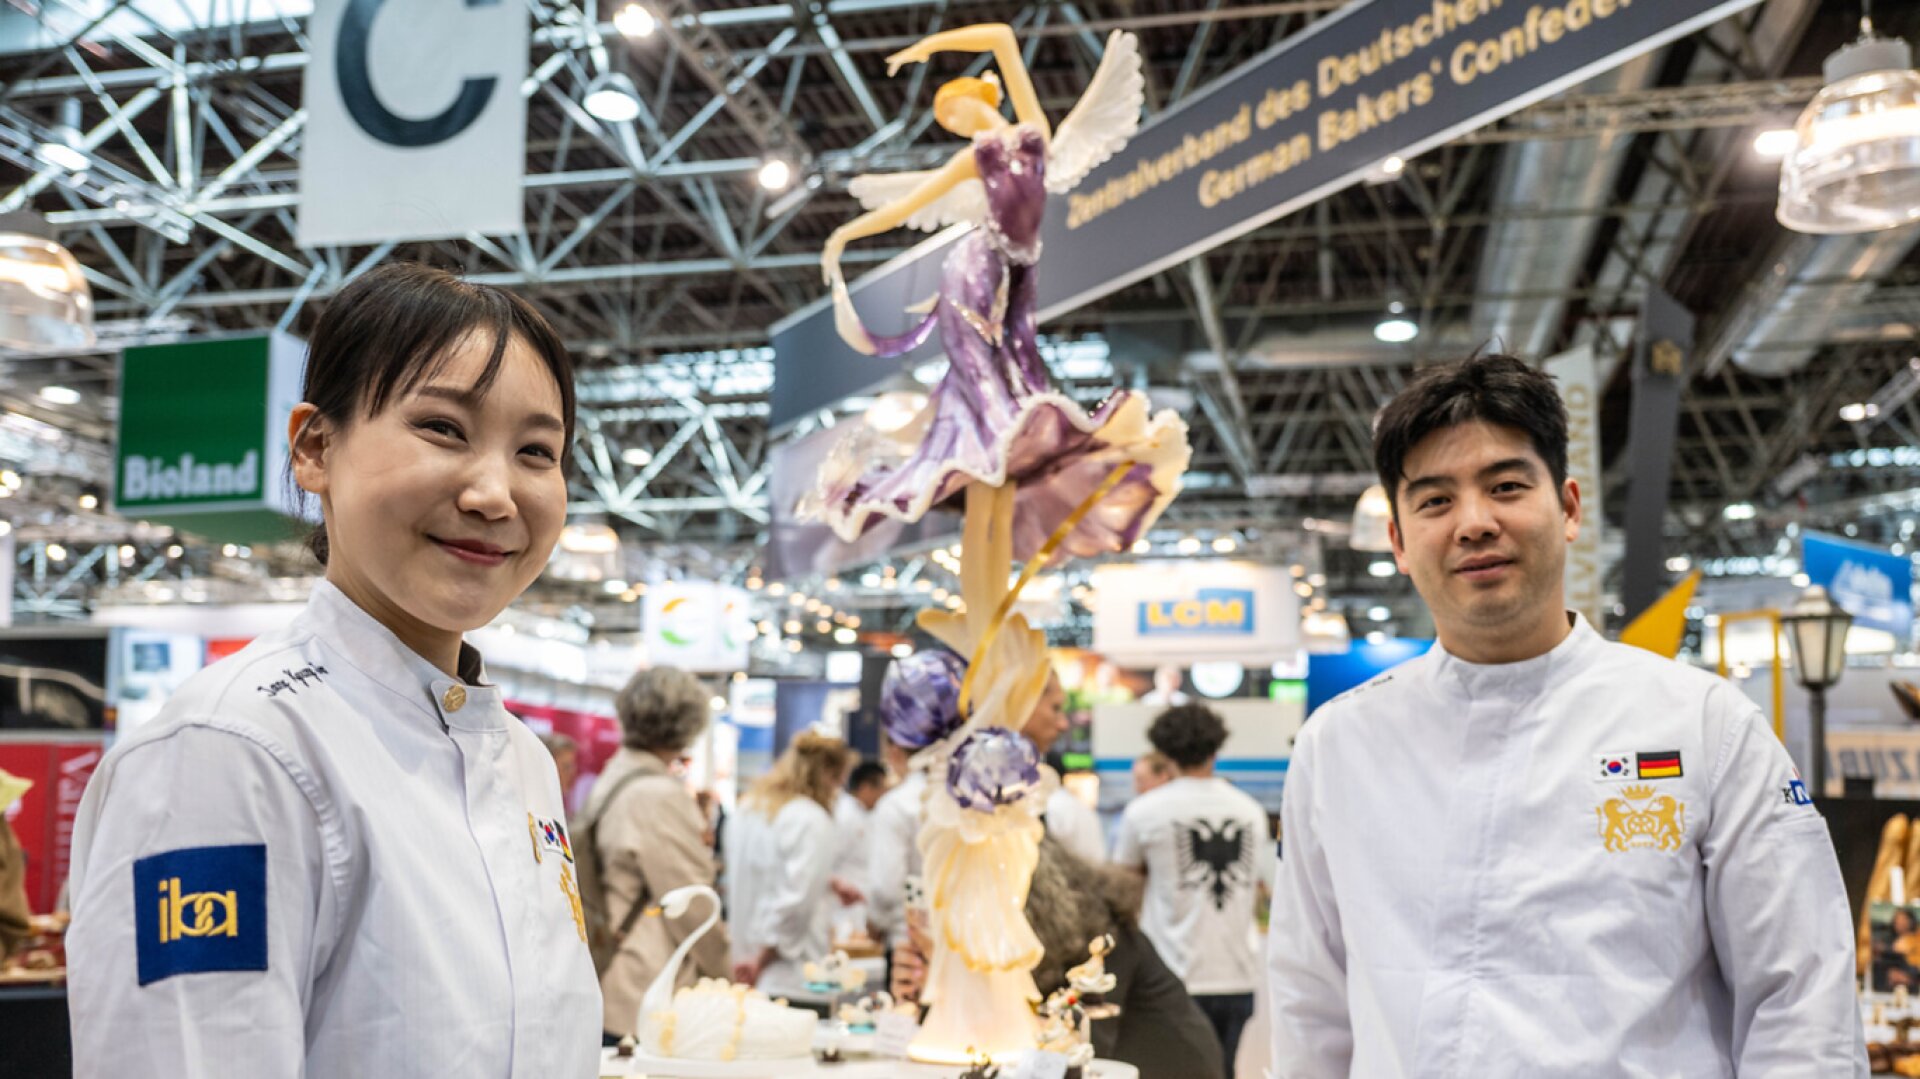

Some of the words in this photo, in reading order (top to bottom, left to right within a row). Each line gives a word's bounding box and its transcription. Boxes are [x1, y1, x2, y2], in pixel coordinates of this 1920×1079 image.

[334, 0, 504, 147] C
[1198, 132, 1310, 208] German
[1450, 0, 1632, 85] Confede
[1066, 102, 1251, 230] Zentralverband
[1255, 79, 1311, 129] des
[123, 449, 258, 500] Bioland
[1147, 599, 1244, 627] LCM
[158, 876, 239, 944] iba
